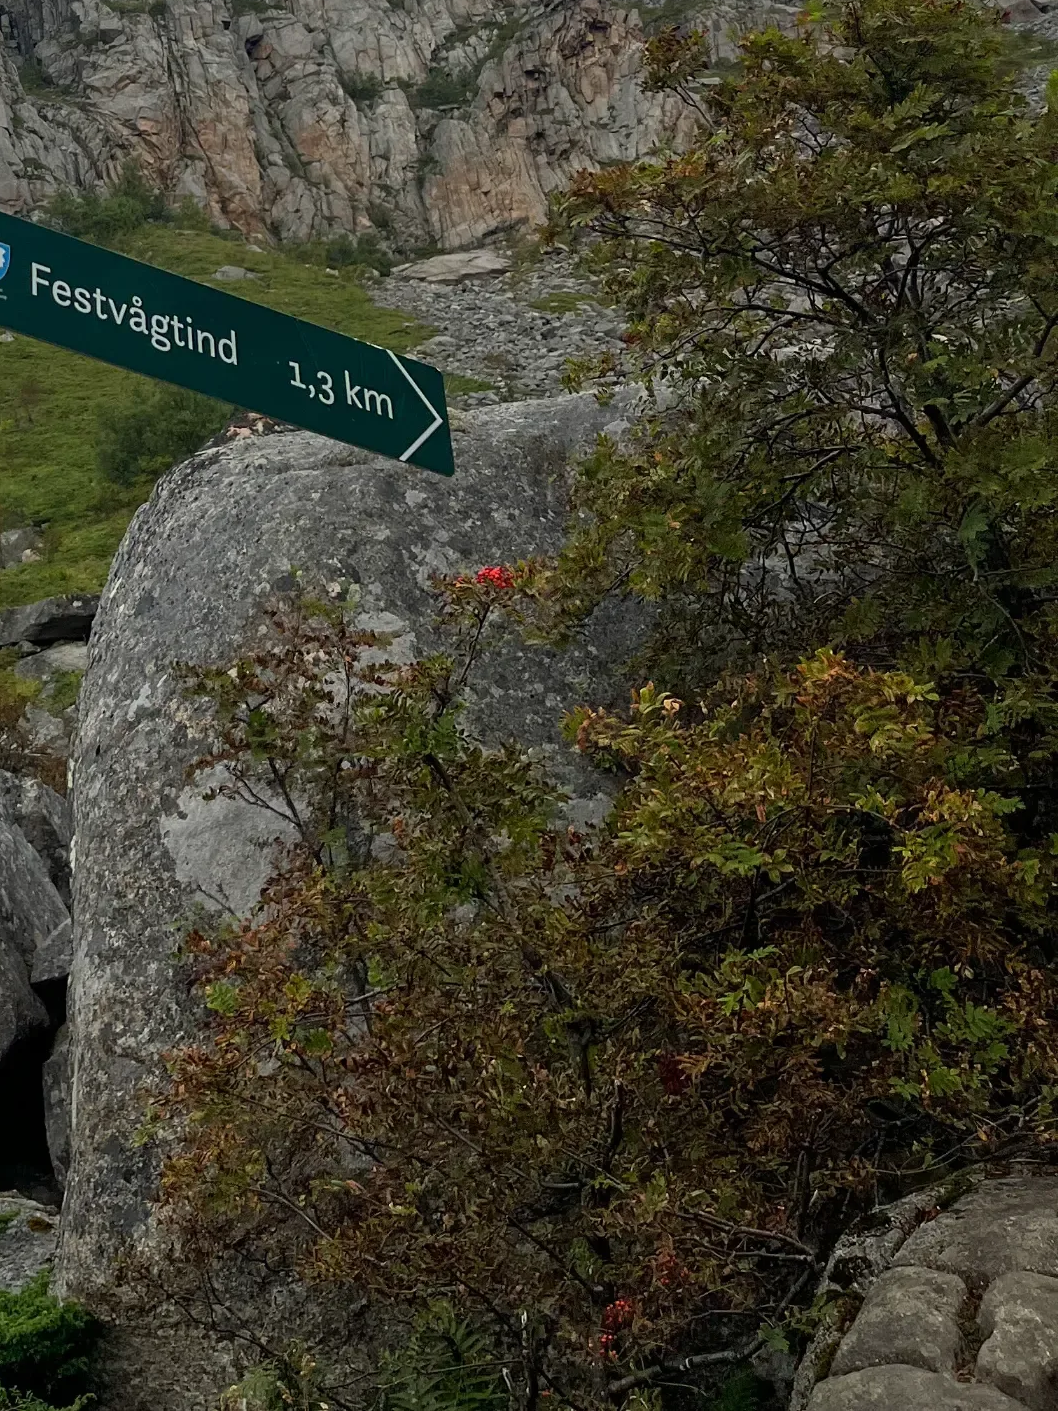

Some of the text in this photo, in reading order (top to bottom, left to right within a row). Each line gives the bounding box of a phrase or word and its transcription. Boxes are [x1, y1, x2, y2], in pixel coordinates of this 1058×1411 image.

[30, 262, 238, 367] Festvågtind
[289, 360, 394, 420] 1,3 km
